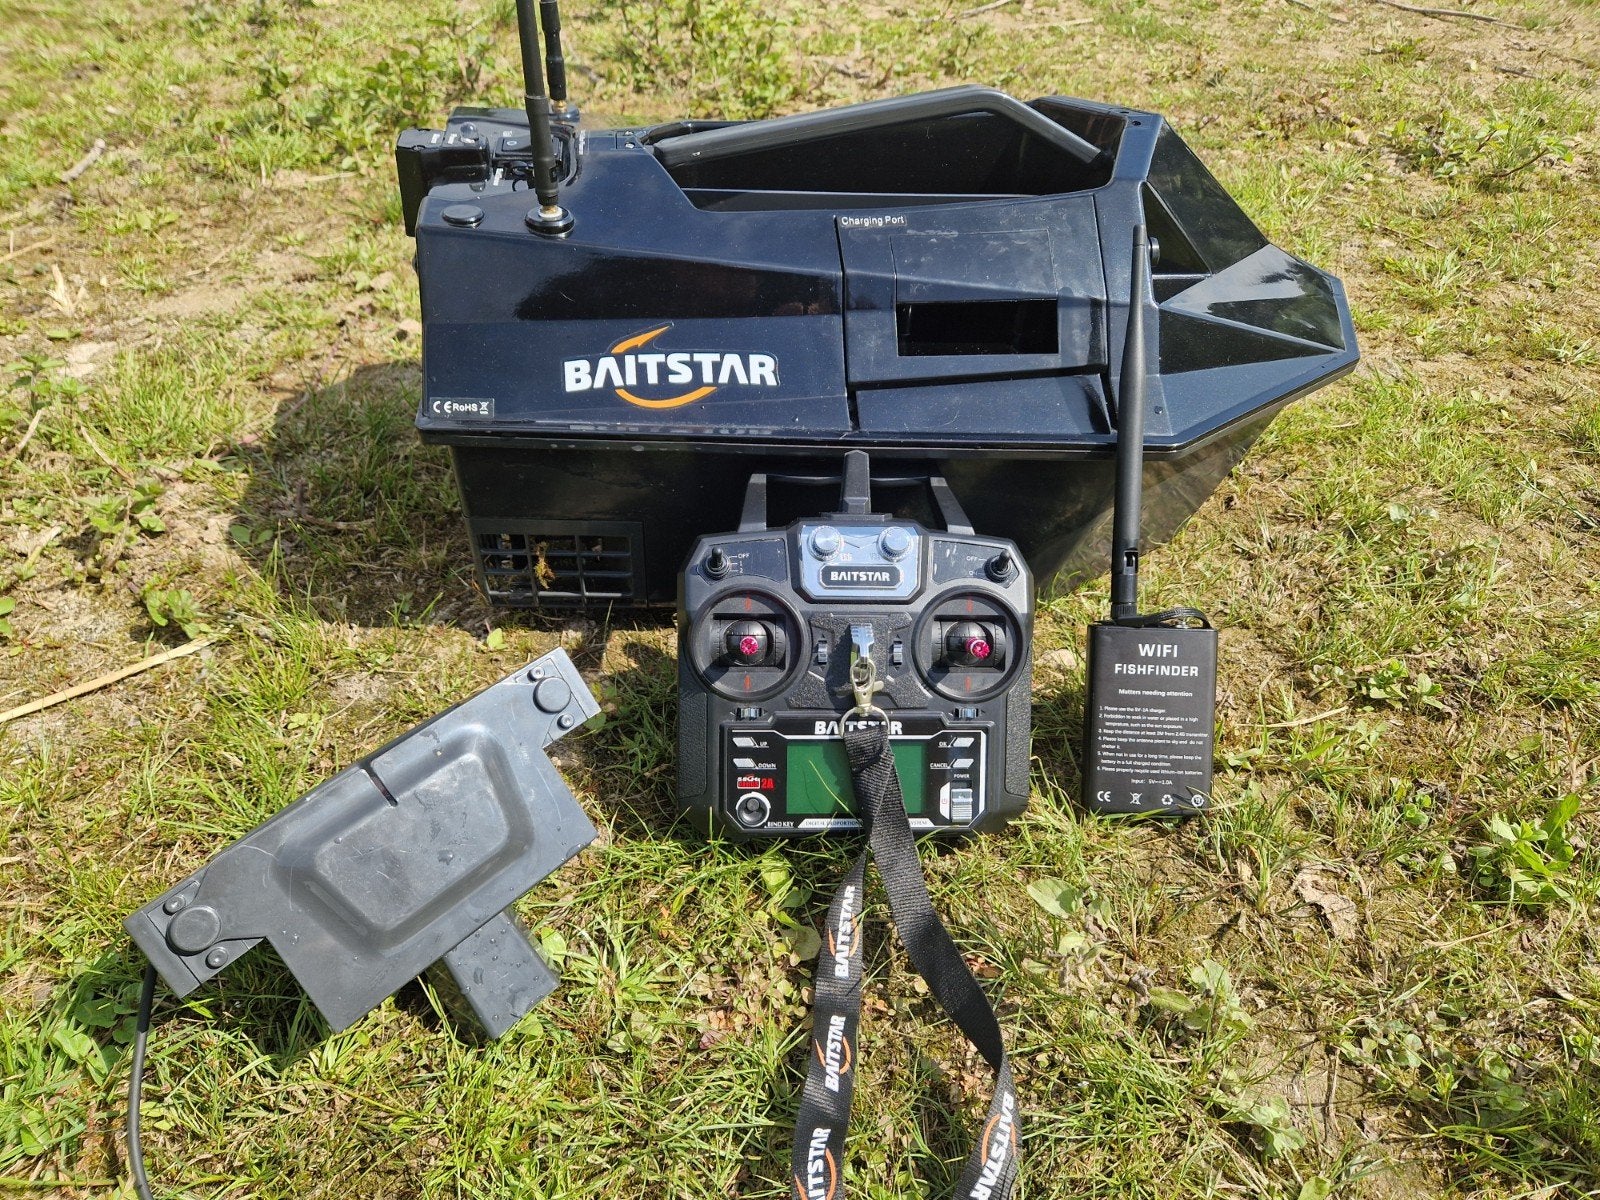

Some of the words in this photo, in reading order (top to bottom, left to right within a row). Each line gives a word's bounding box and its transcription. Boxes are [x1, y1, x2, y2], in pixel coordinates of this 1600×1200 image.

[841, 216, 883, 226] Charging
[884, 216, 904, 224] Port
[564, 353, 778, 392] BAITSTAR
[433, 400, 452, 414] CE
[452, 402, 478, 412] RoHS
[830, 572, 890, 582] BAITSTAR
[1138, 644, 1178, 658] WIFI
[1114, 663, 1199, 677] FISHFINDER
[815, 721, 902, 734] BATSR
[761, 778, 774, 789] 2A
[835, 885, 856, 978] BAITSTAR
[824, 1015, 846, 1092] BAITSTAR
[807, 1128, 832, 1200] ITSTAR
